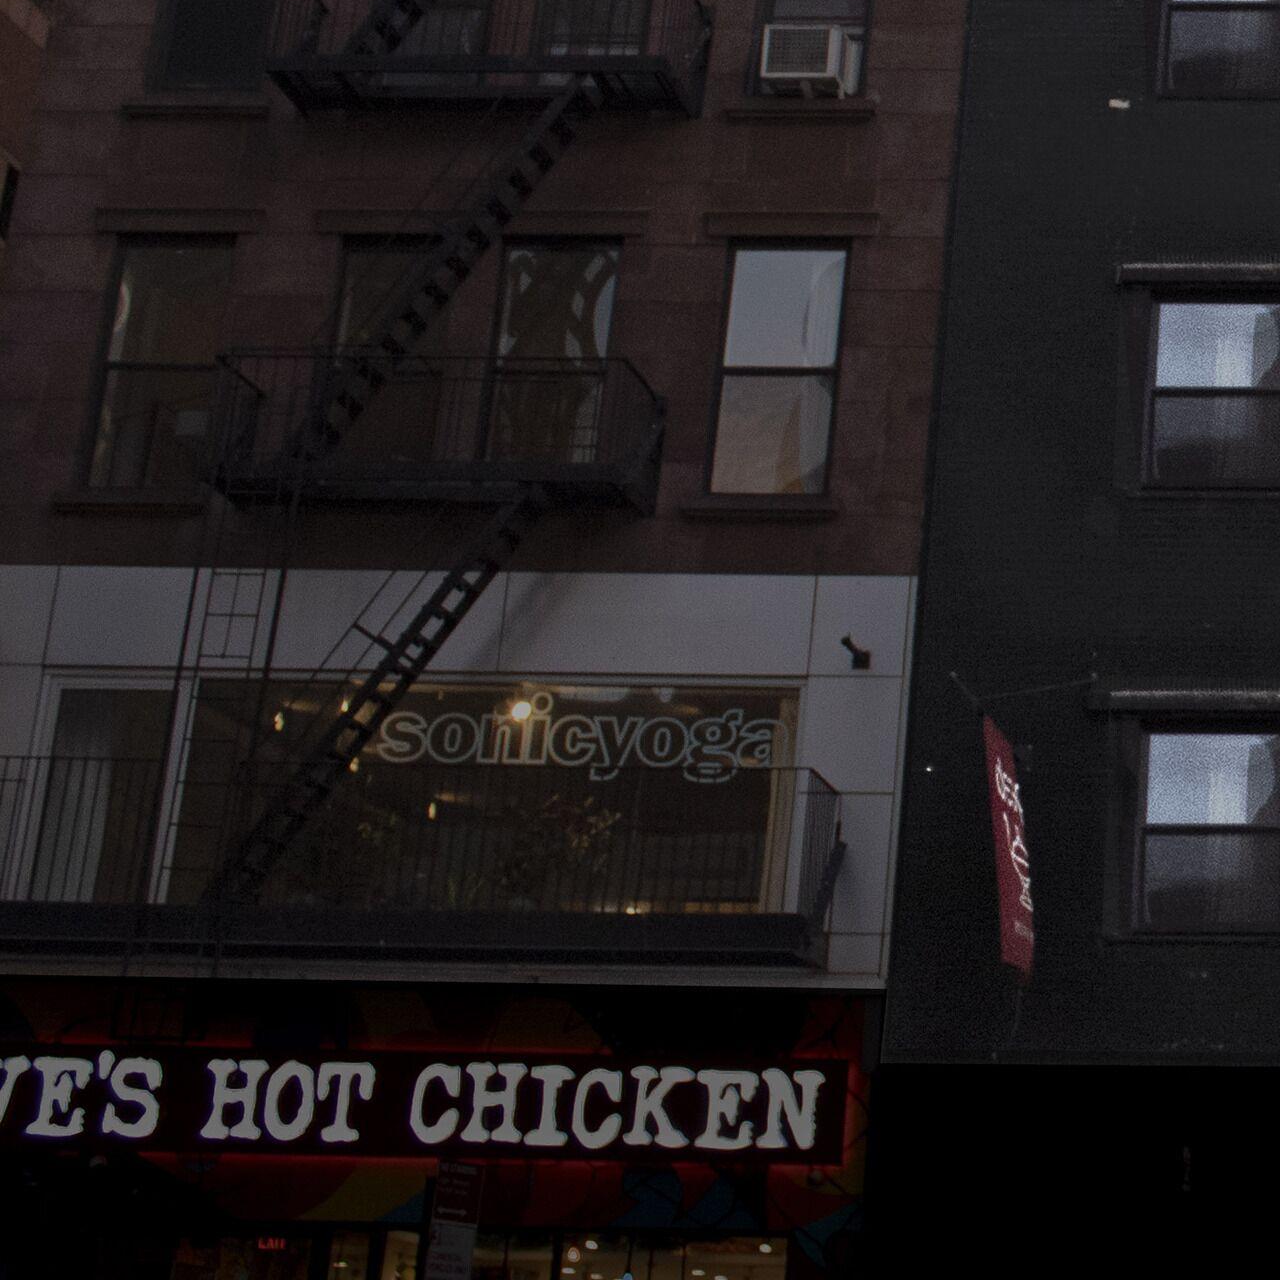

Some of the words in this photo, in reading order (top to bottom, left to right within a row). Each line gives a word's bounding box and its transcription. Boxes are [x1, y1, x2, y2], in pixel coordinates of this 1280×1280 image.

[378, 691, 788, 784] sonicyoga
[199, 1057, 377, 1143] HOT
[408, 1060, 827, 1151] CHICKEN
